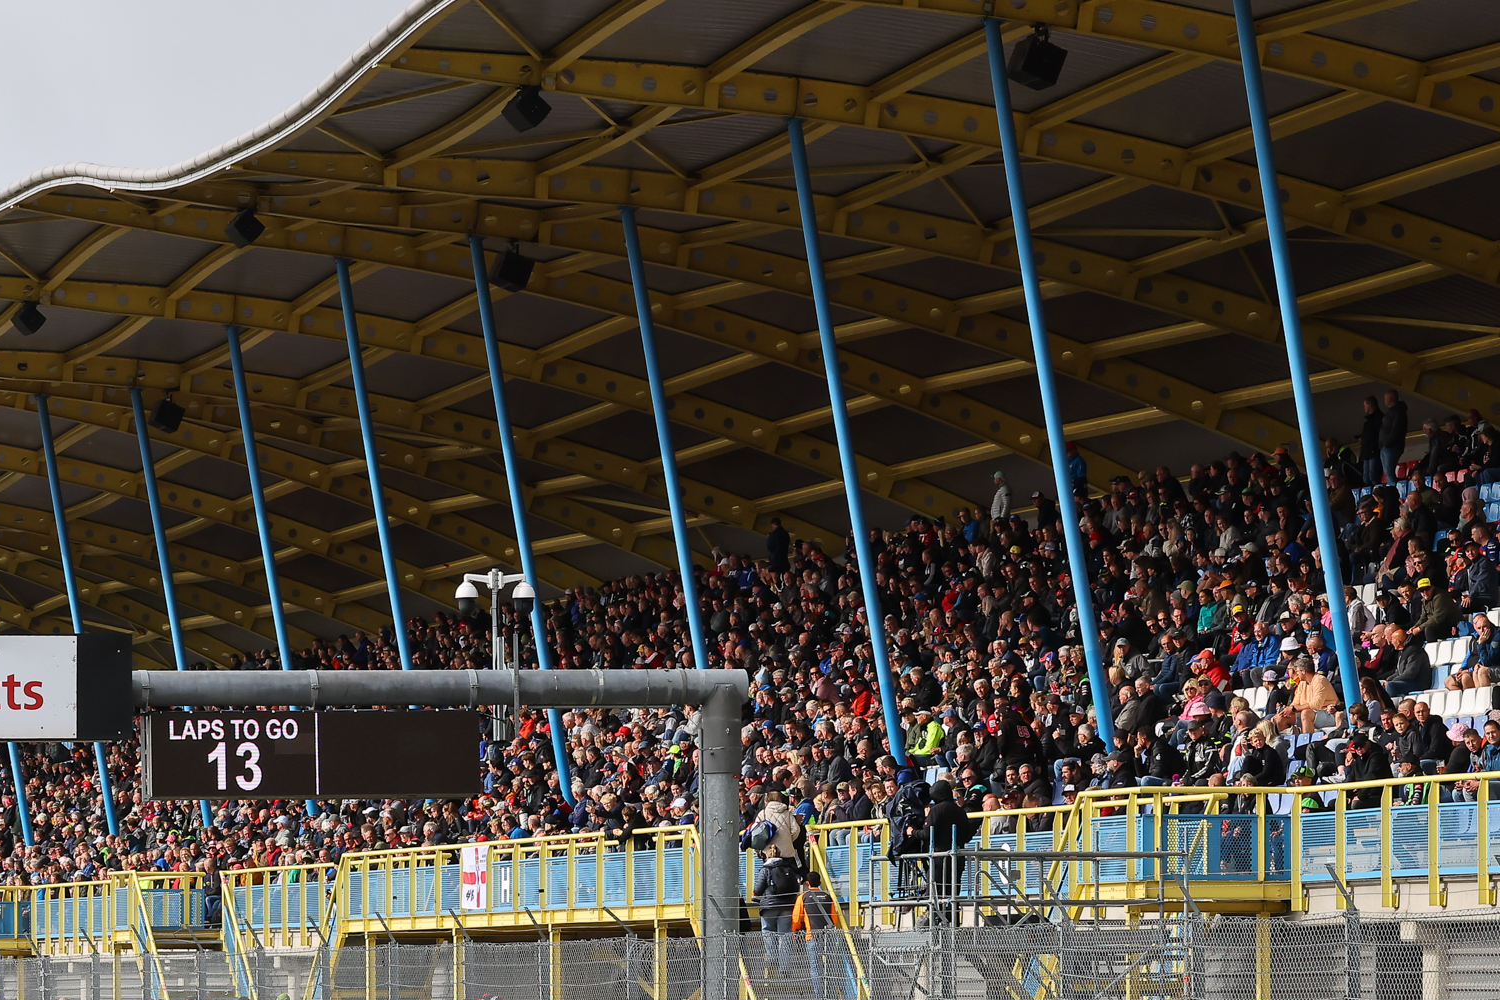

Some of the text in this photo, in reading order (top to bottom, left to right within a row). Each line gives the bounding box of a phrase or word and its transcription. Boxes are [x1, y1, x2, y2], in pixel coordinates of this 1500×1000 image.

[169, 718, 298, 741] LAPS TO GO
[207, 741, 262, 791] 13
